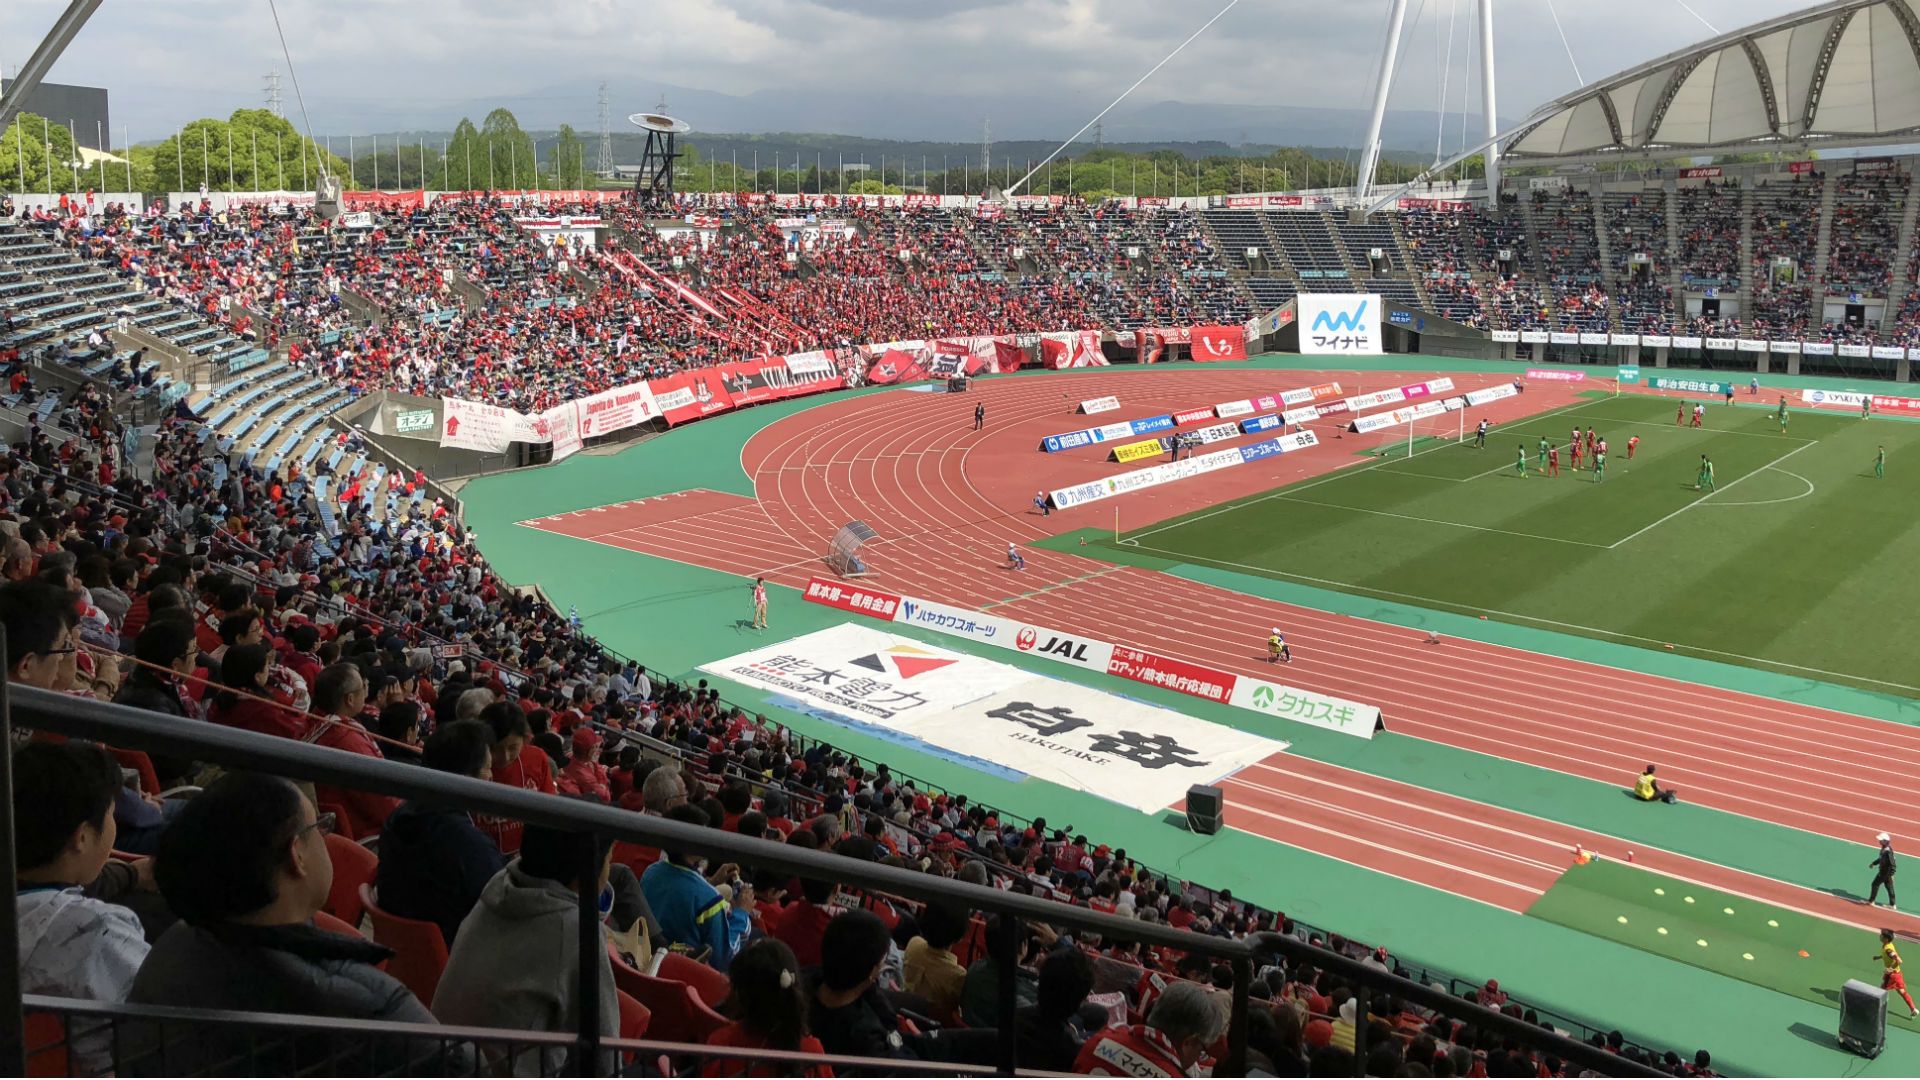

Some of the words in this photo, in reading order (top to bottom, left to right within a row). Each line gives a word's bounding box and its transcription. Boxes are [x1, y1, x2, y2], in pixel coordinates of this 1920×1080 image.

[1312, 336, 1369, 350] マイナビ
[1656, 378, 1720, 392] 明治安田生命
[640, 401, 650, 416] 12
[583, 418, 592, 435] 12
[1209, 424, 1238, 440] 日本製紙
[1067, 484, 1106, 503] 九州産交
[807, 582, 895, 614] 熊本第一信用金庫
[916, 608, 997, 637] ハヤカワスポーツ
[1038, 637, 1088, 662] JAL
[751, 654, 928, 711] 熊本電力
[1277, 692, 1355, 726] タカスギ
[1008, 731, 1111, 766] HAKUTAKE
